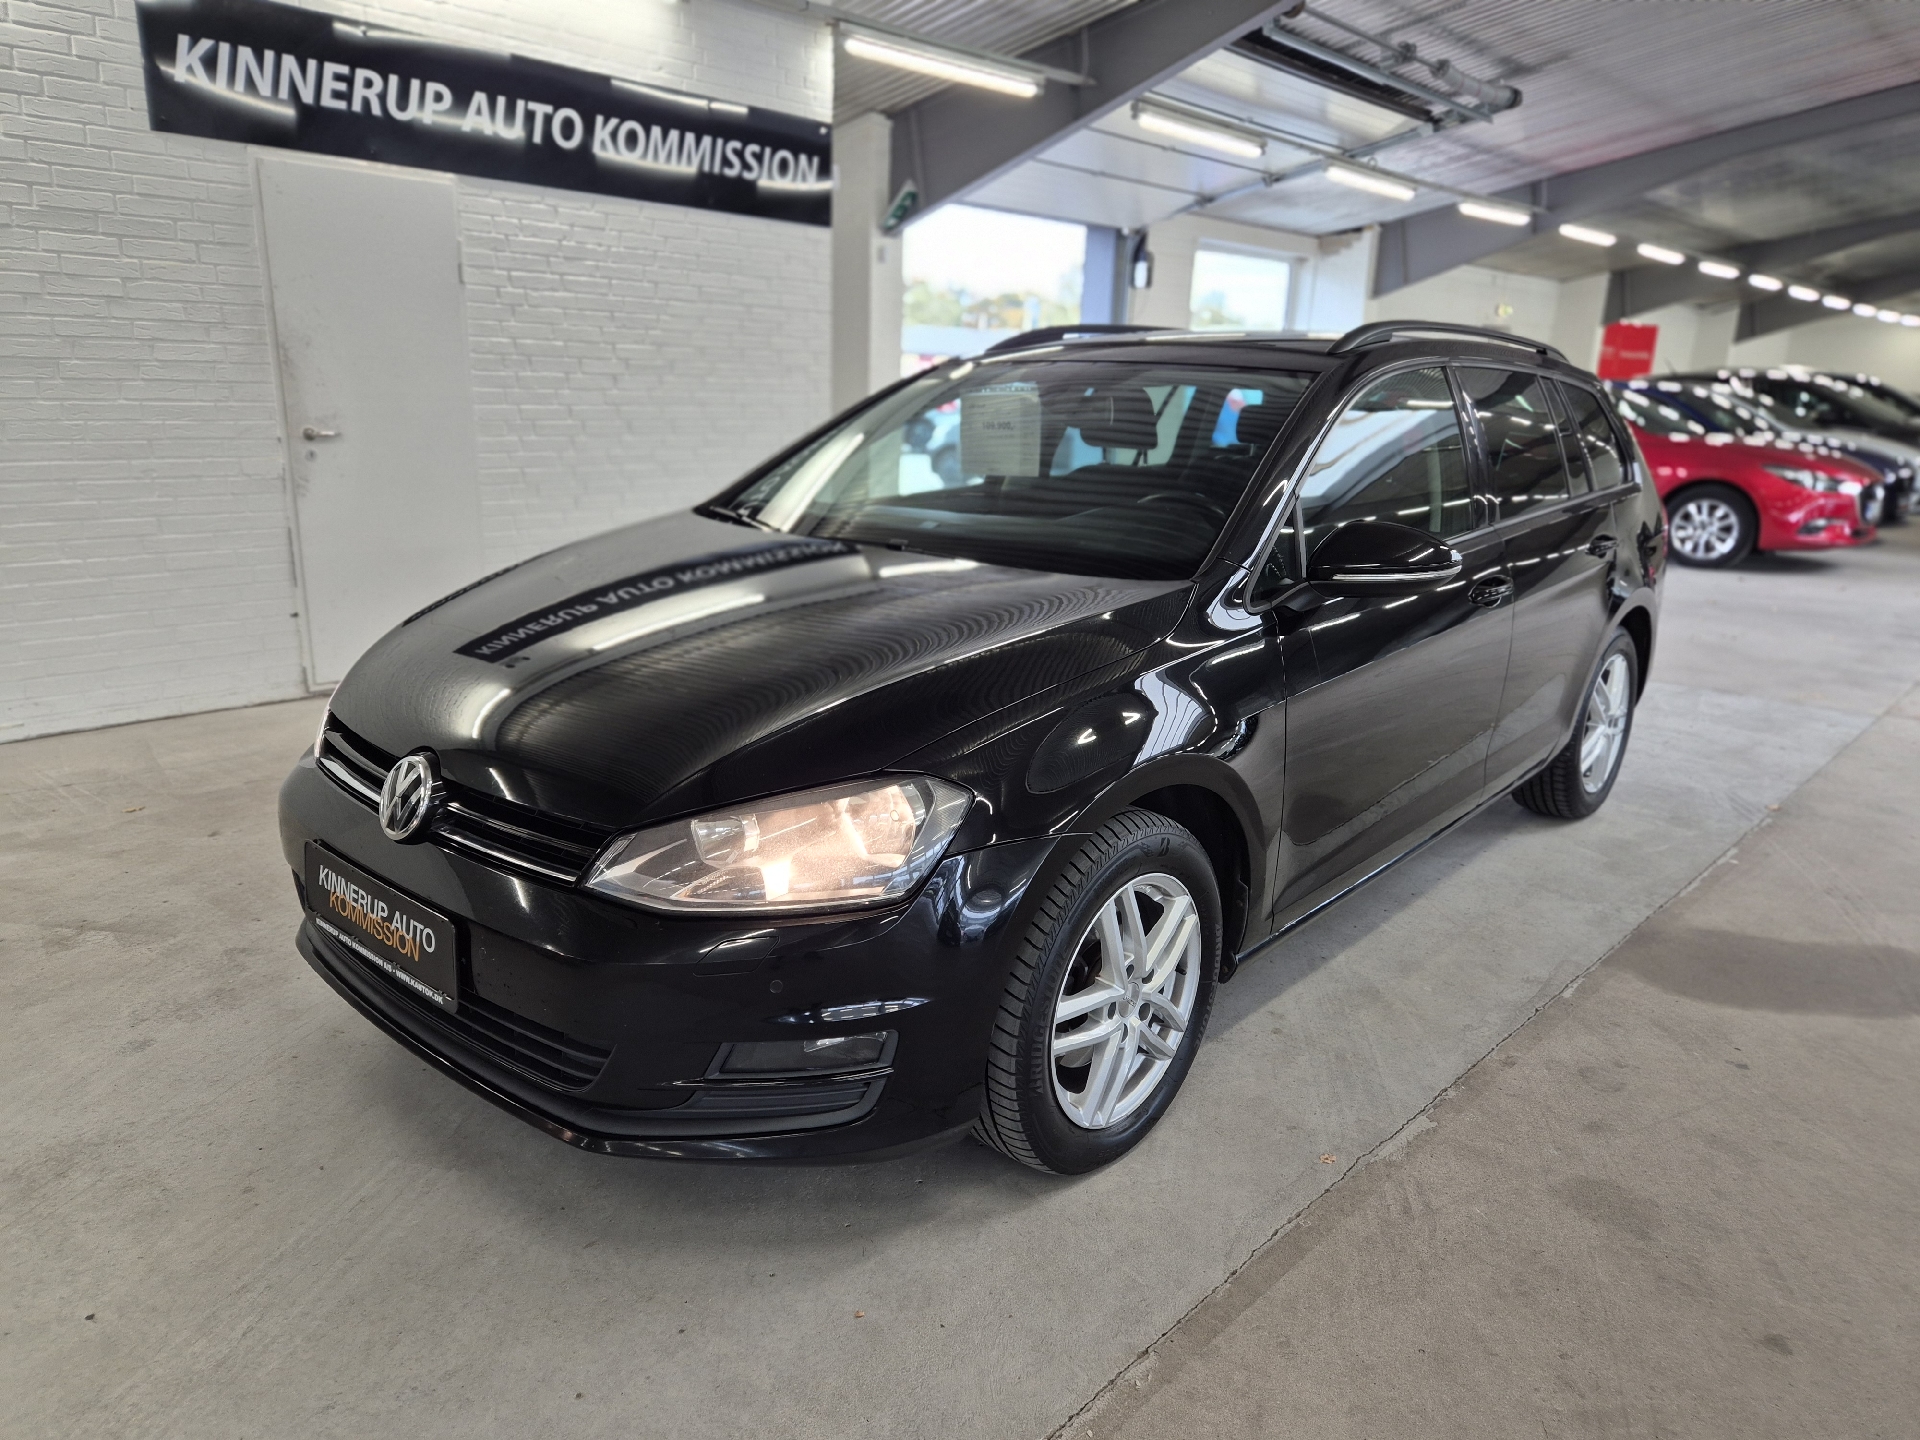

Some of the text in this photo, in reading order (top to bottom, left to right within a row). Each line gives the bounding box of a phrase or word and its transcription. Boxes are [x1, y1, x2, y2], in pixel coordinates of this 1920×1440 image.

[173, 34, 820, 184] KINNERUP AUTO KOMMISSION
[318, 864, 436, 953] KINNERUP AUTO
[329, 889, 421, 962] KOMMISSION
